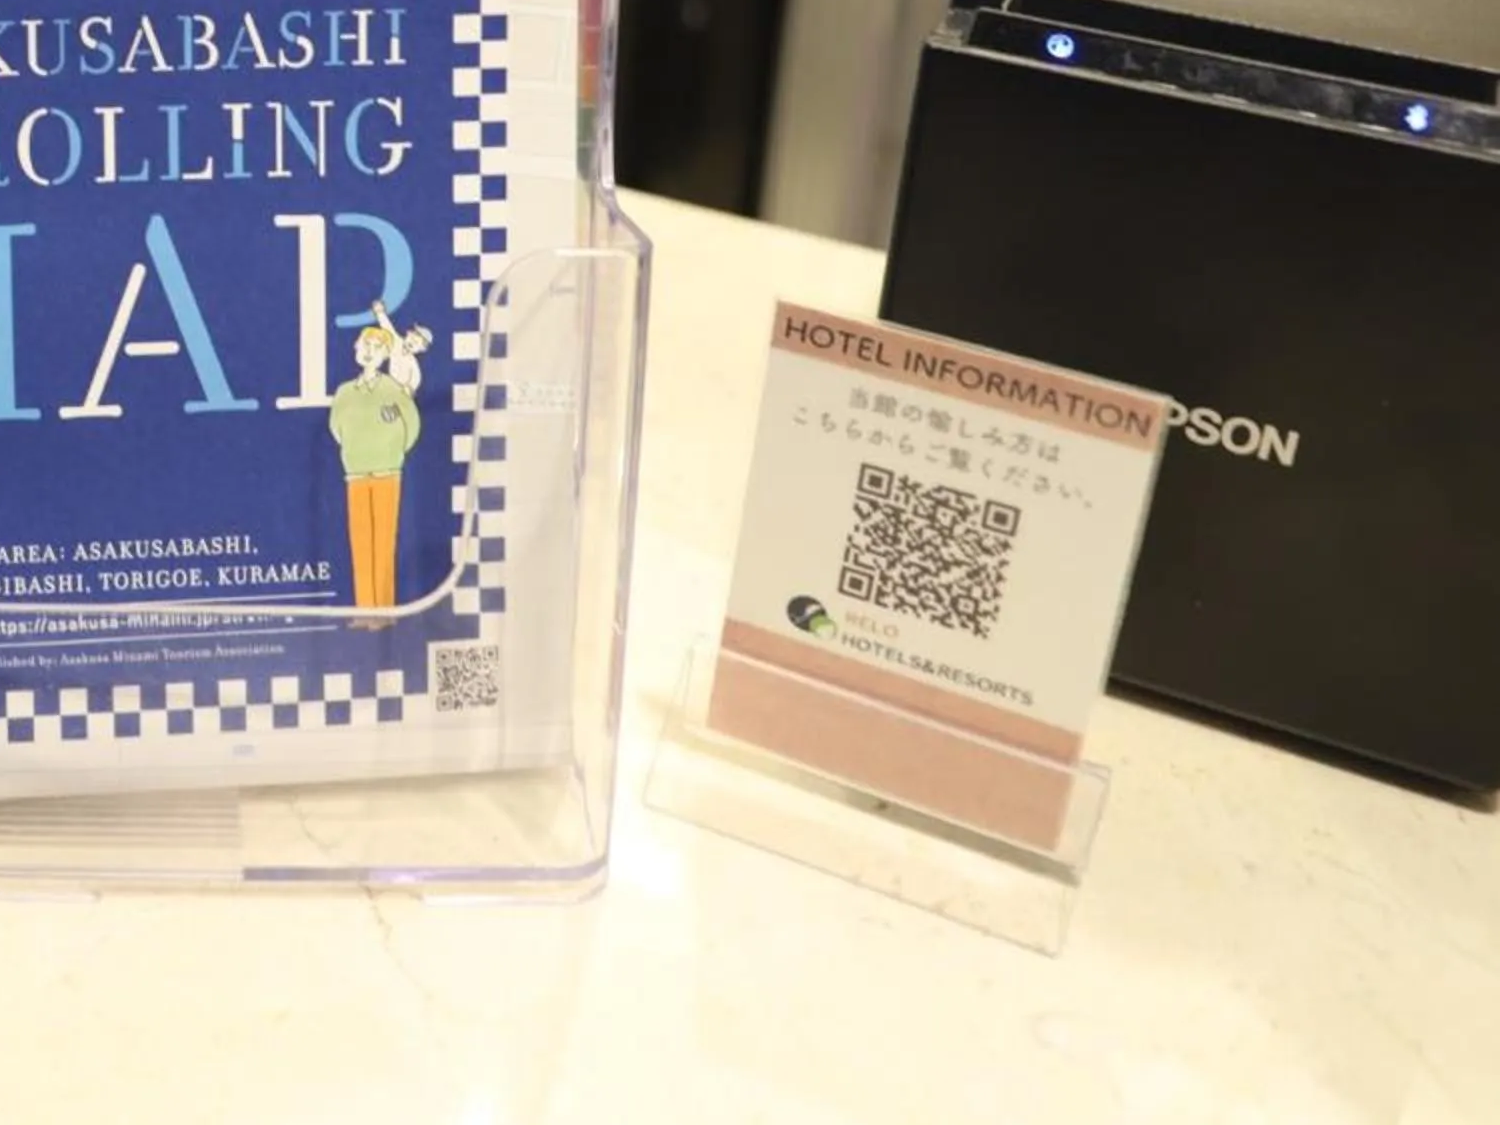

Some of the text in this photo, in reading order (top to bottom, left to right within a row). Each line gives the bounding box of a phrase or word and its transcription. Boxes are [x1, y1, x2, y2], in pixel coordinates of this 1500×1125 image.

[784, 316, 1154, 439] HOTEL INFORMATION
[217, 561, 332, 586] KURAMAE
[840, 633, 1035, 707] HOTELS&RESORTS
